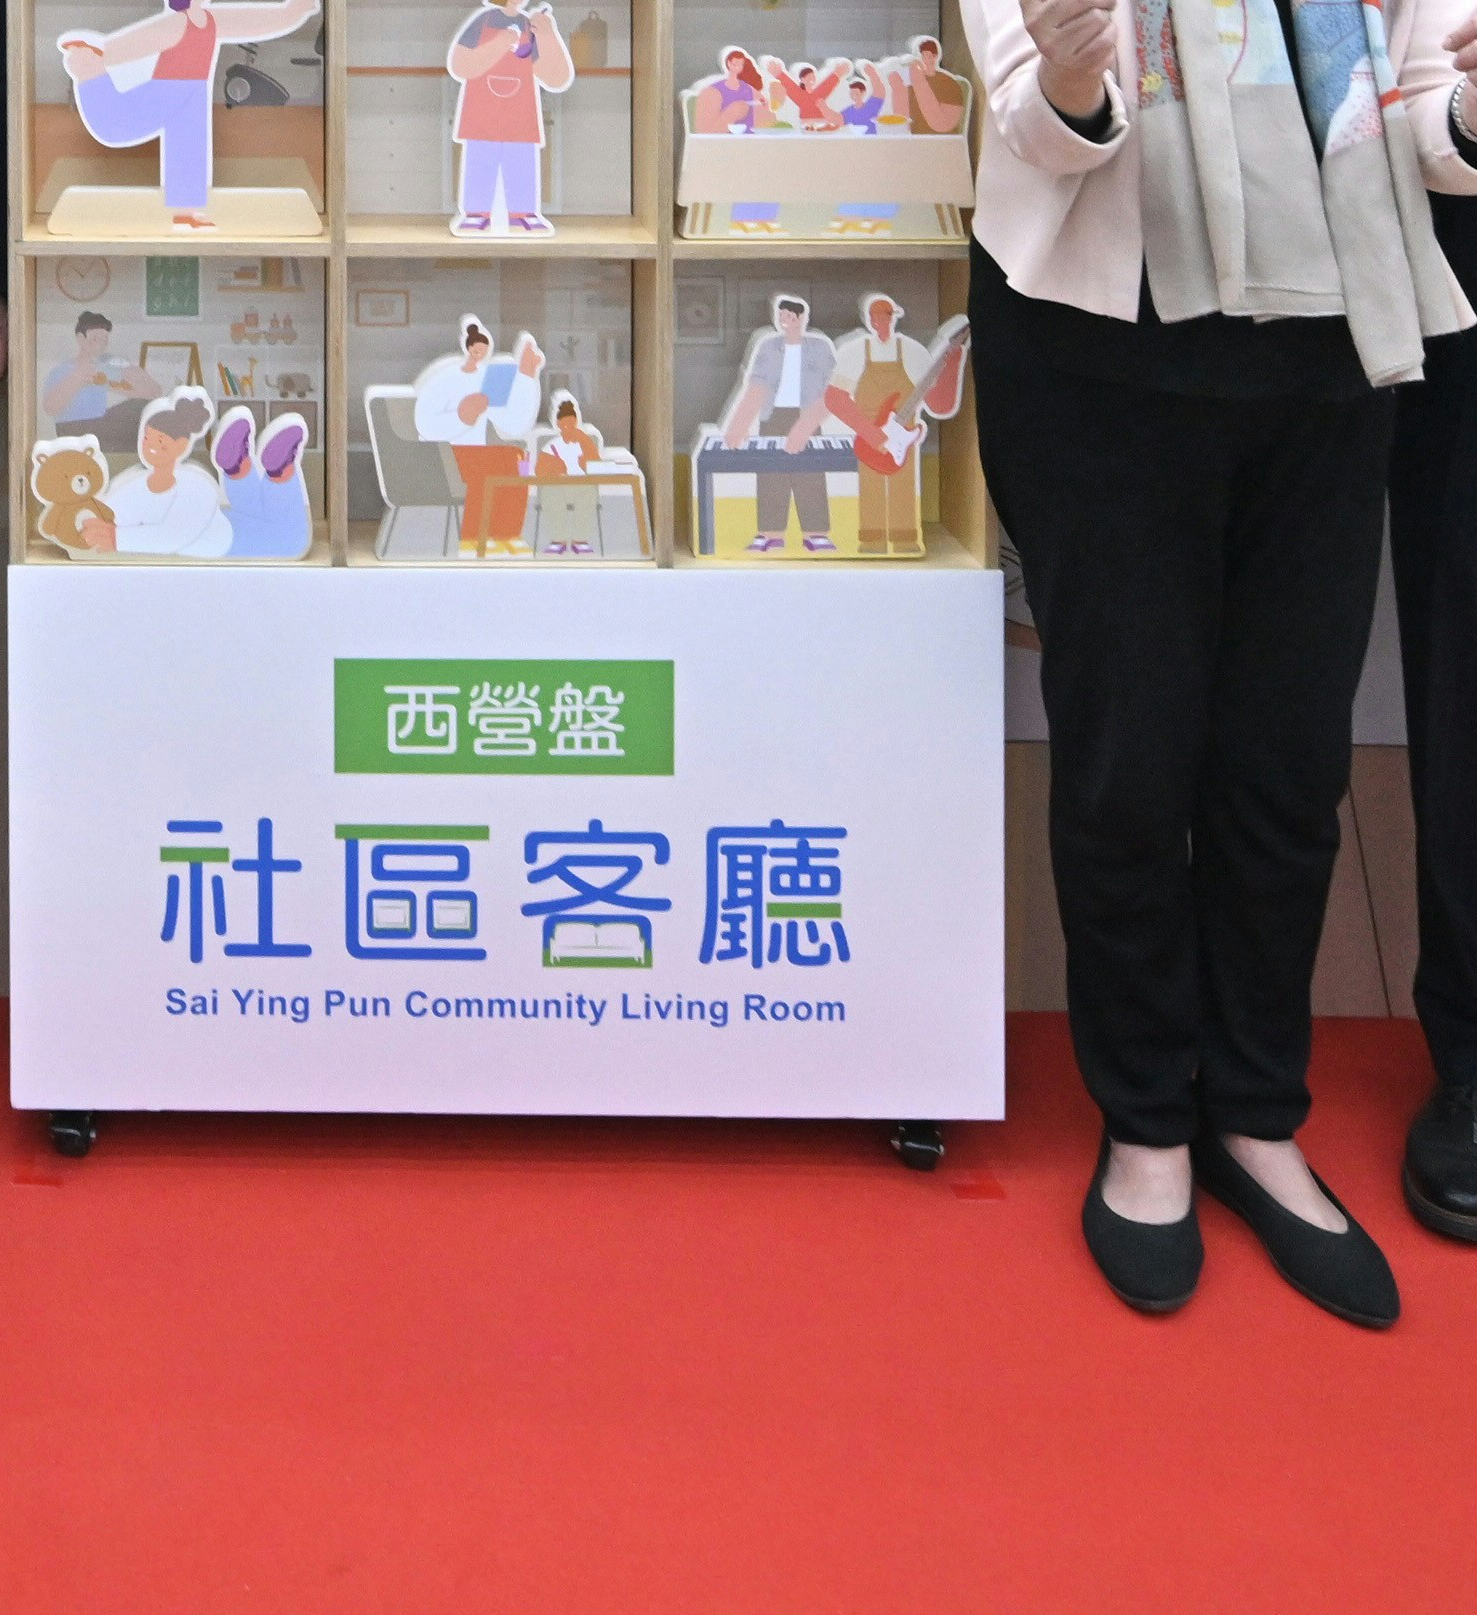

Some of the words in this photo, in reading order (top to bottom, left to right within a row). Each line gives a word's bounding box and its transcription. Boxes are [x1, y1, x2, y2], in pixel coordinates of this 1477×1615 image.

[383, 682, 626, 757] 西營盤
[160, 818, 850, 969] 社區客廳
[166, 989, 217, 1015] Sai
[232, 989, 309, 1023] Ying
[325, 990, 390, 1017] Pun
[406, 991, 606, 1026] Community
[622, 994, 728, 1027] Living
[744, 994, 845, 1021] Room
